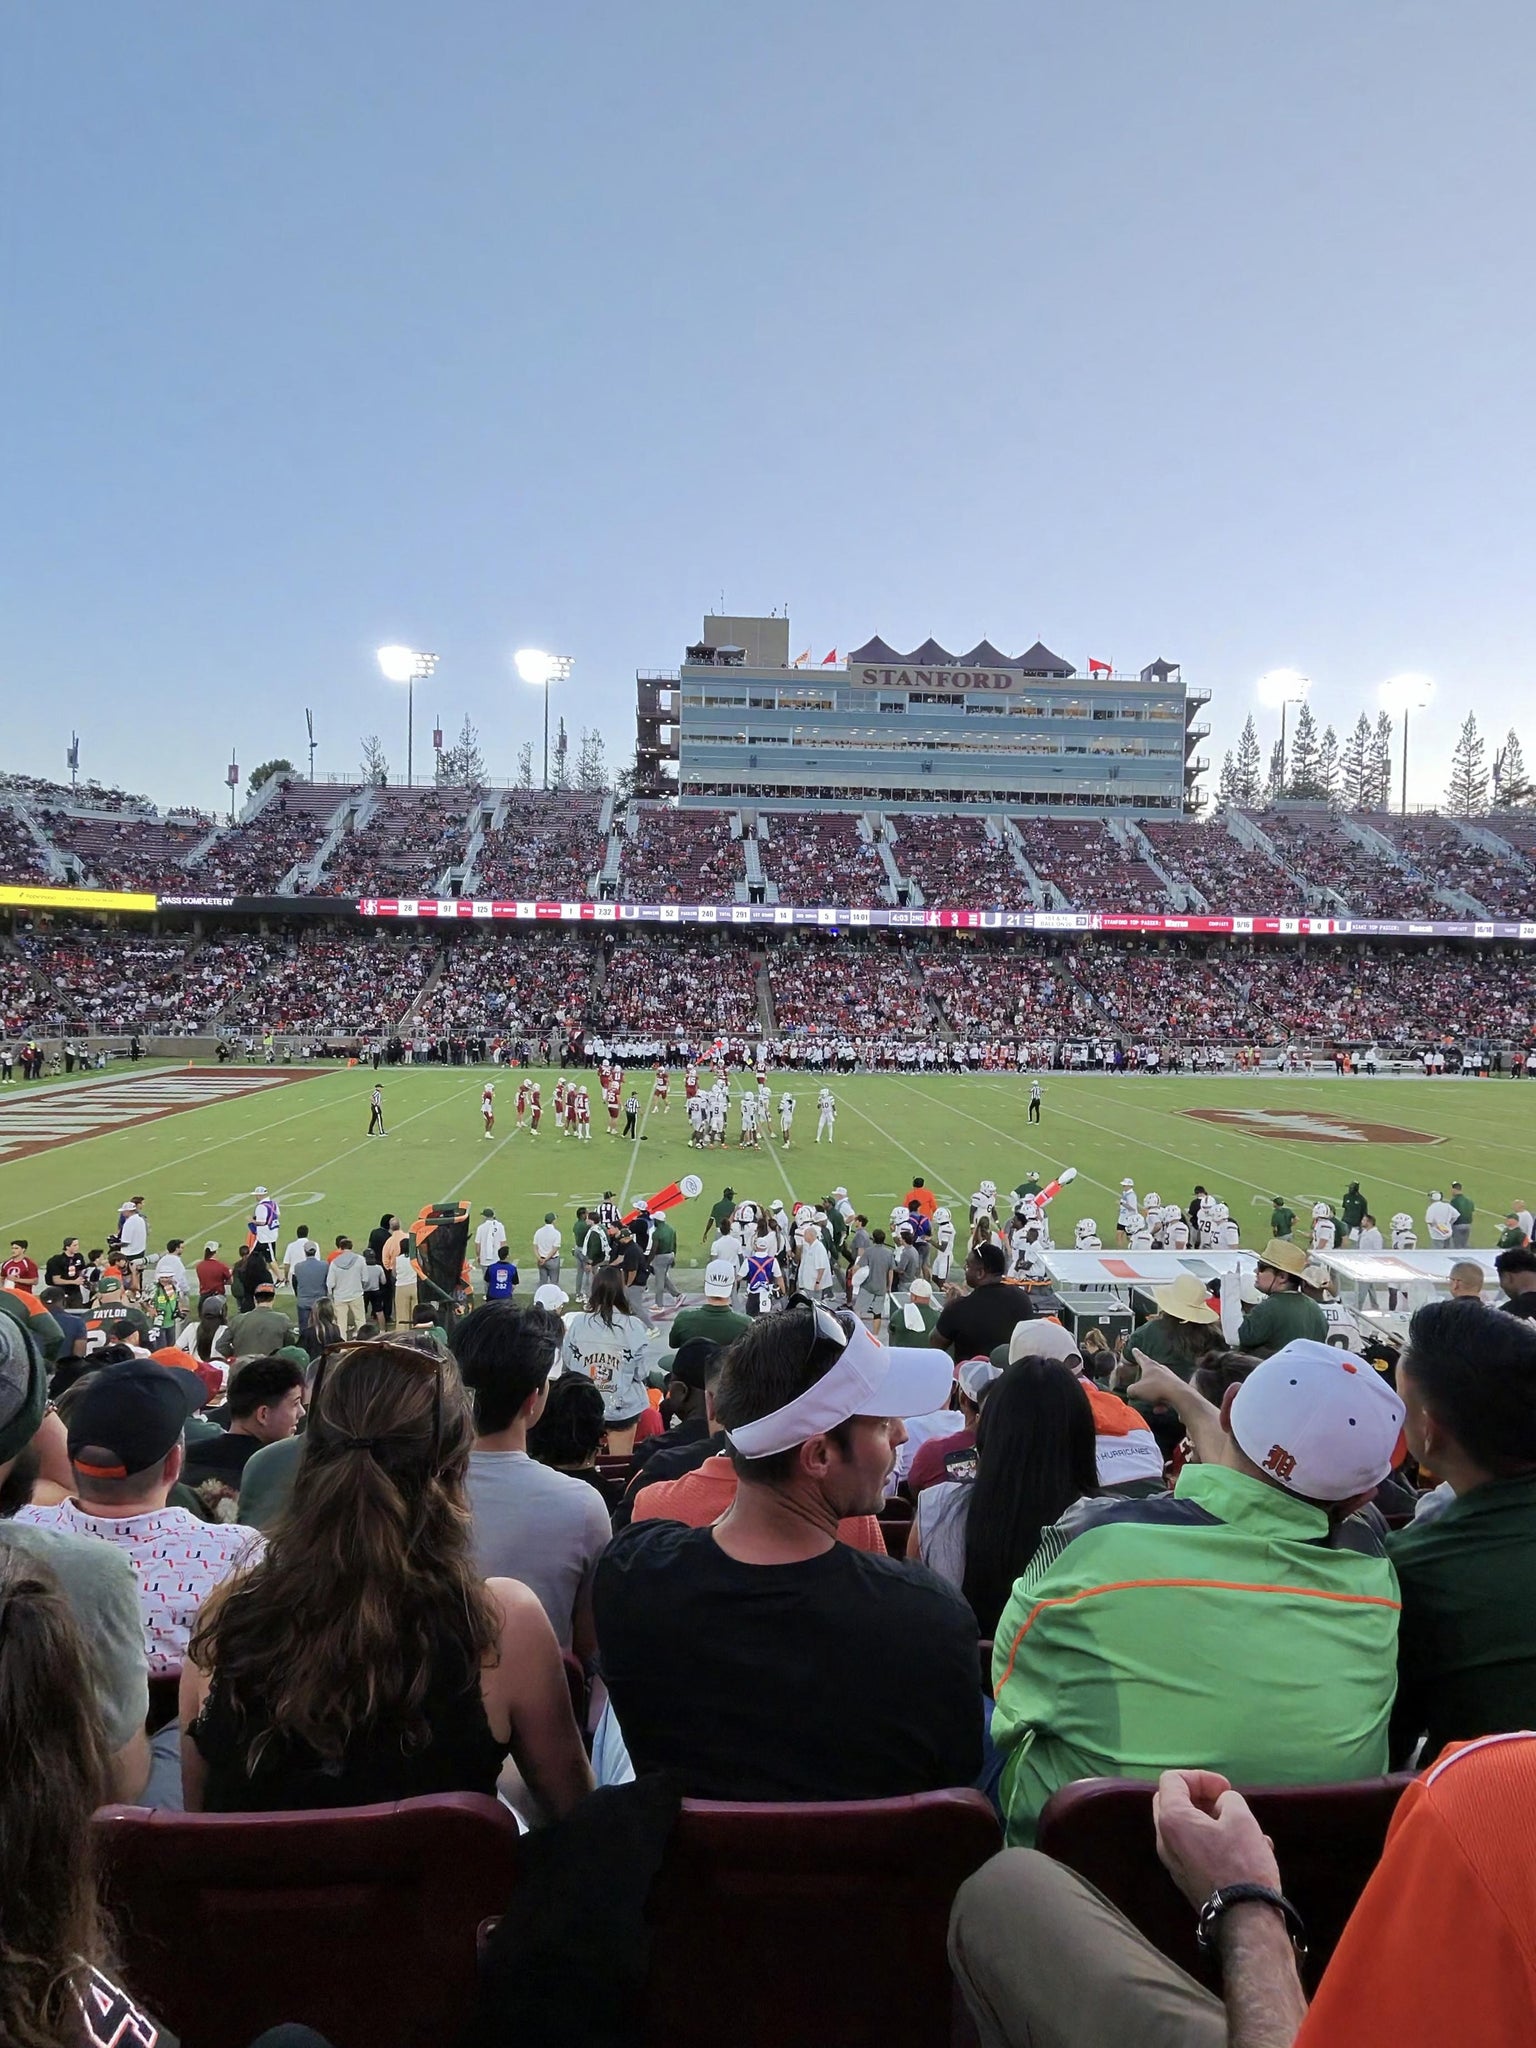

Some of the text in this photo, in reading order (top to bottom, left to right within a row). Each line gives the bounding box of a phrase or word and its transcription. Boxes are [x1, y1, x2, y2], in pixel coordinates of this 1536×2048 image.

[862, 668, 1013, 690] STANFORD
[161, 896, 234, 906] PASS COMPLETE BY
[892, 914, 909, 922] 4:03
[951, 913, 959, 925] 3
[1006, 915, 1020, 925] 21
[1200, 1220, 1211, 1233] 79
[93, 1308, 128, 1319] TAYLOR
[583, 1352, 620, 1370] MIAMI
[1101, 1447, 1153, 1460] HURRICANES
